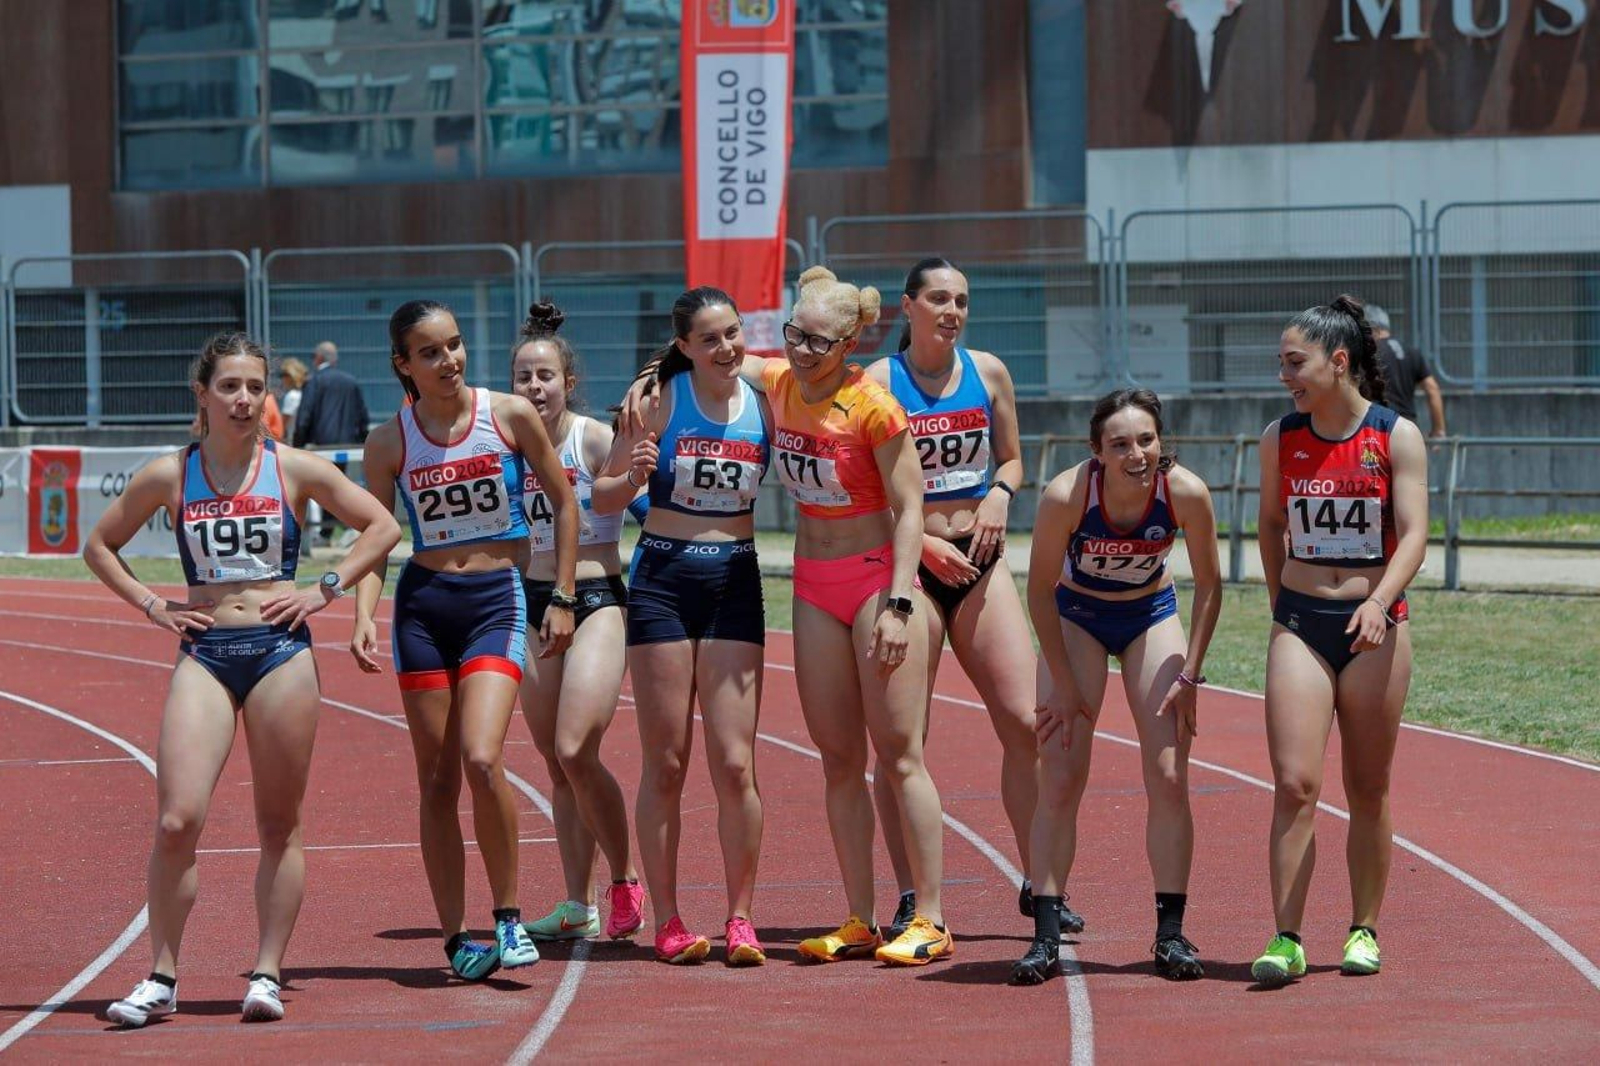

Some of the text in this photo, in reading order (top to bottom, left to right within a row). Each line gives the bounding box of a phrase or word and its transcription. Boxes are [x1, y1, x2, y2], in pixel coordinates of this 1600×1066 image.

[717, 69, 739, 225] CONCELLO
[746, 87, 767, 205] DE VIGO
[915, 430, 983, 470] 287
[694, 458, 743, 490] 63
[780, 451, 823, 488] 171
[418, 478, 500, 522] 293
[1294, 498, 1371, 535] 144
[193, 517, 269, 557] 195
[642, 537, 673, 551] ZICO
[683, 545, 720, 555] ZICO
[1092, 555, 1159, 571] 174
